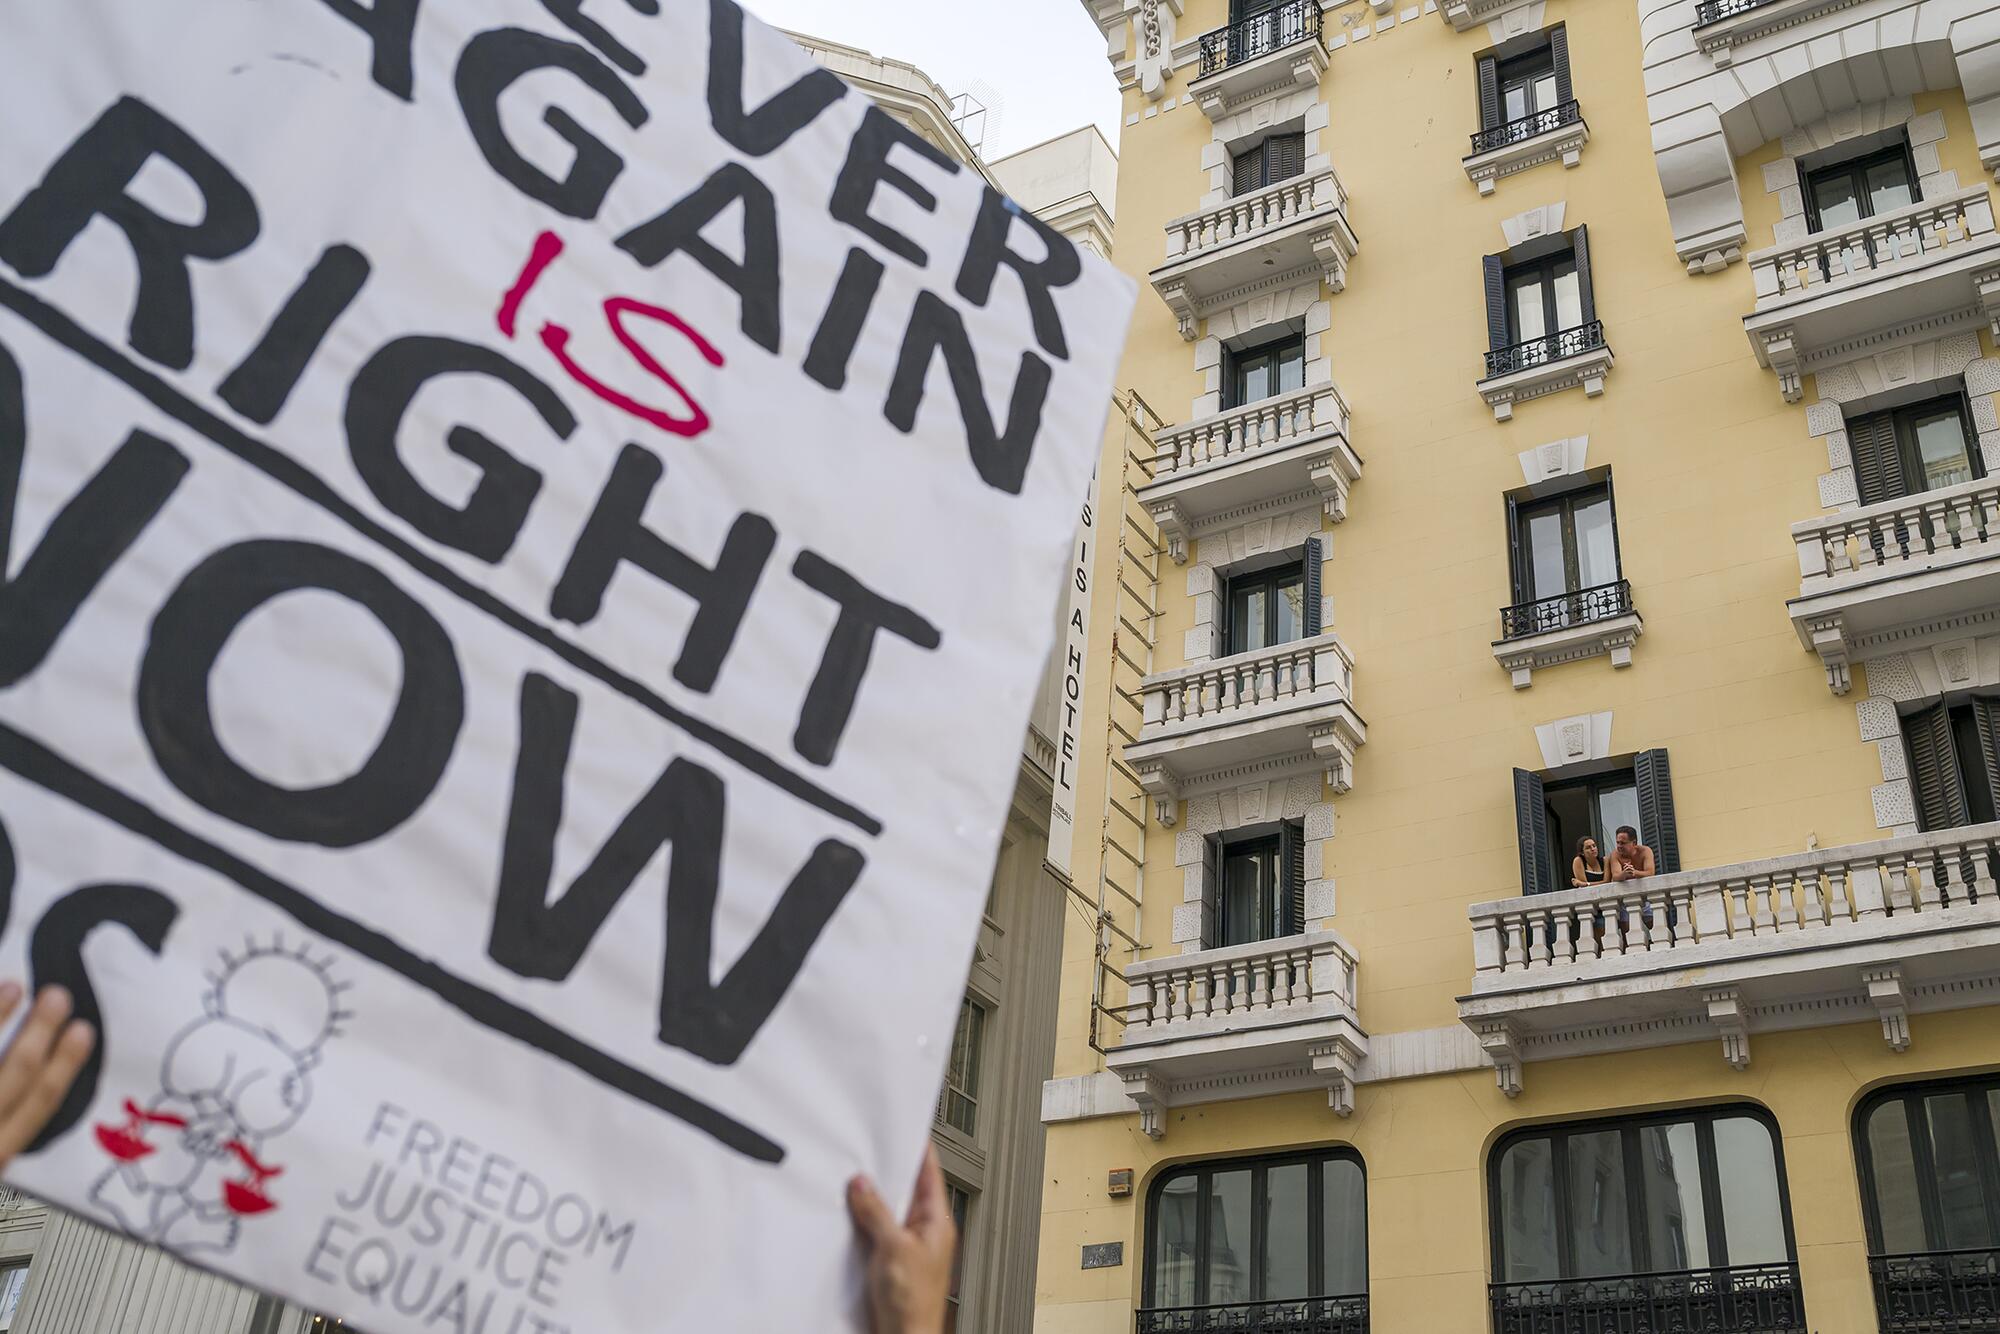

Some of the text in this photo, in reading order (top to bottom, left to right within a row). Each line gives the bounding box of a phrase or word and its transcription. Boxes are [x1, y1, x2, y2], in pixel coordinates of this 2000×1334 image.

[496, 229, 726, 439] IS
[0, 94, 942, 768] RIGHT
[1071, 608, 1084, 635] A
[1060, 644, 1081, 791] HOTEL
[334, 1160, 570, 1308] JUSTICE
[365, 1100, 637, 1275] FREEDOM
